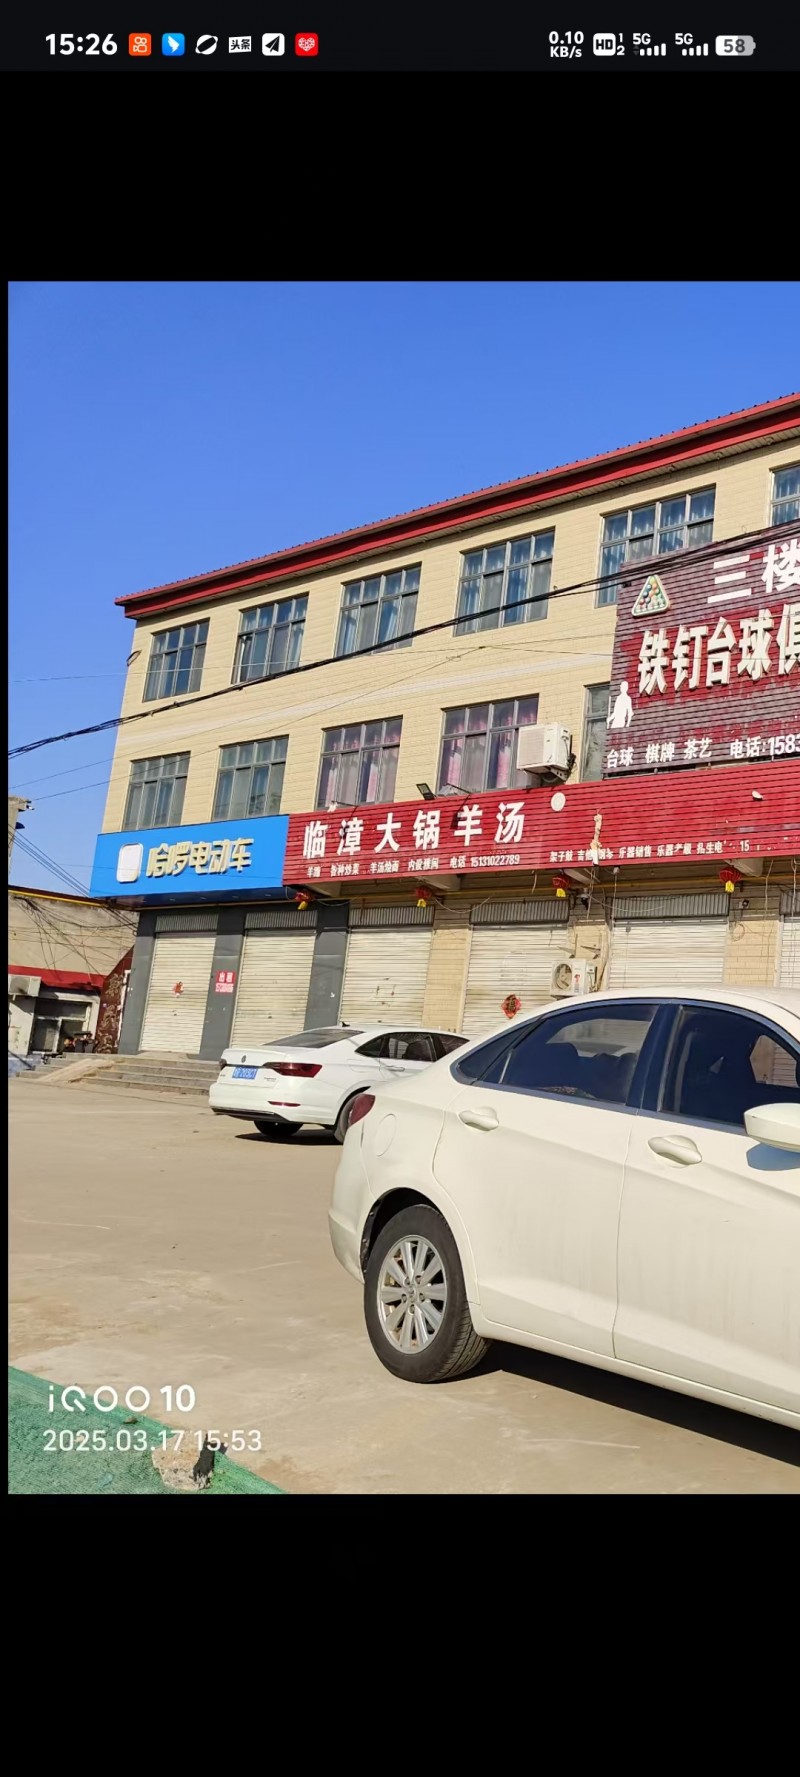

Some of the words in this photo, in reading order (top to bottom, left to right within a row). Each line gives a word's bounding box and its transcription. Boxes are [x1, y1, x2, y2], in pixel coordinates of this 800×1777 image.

[707, 539, 800, 604] 三楼
[637, 603, 800, 696] 铁钉台球俱
[606, 748, 634, 769] 台球
[645, 741, 675, 764] 棋牌
[684, 737, 713, 760] 茶艺
[302, 801, 525, 859] 临漳大锅羊汤
[146, 837, 254, 878] 哈啰电动车
[449, 855, 467, 869] 电话
